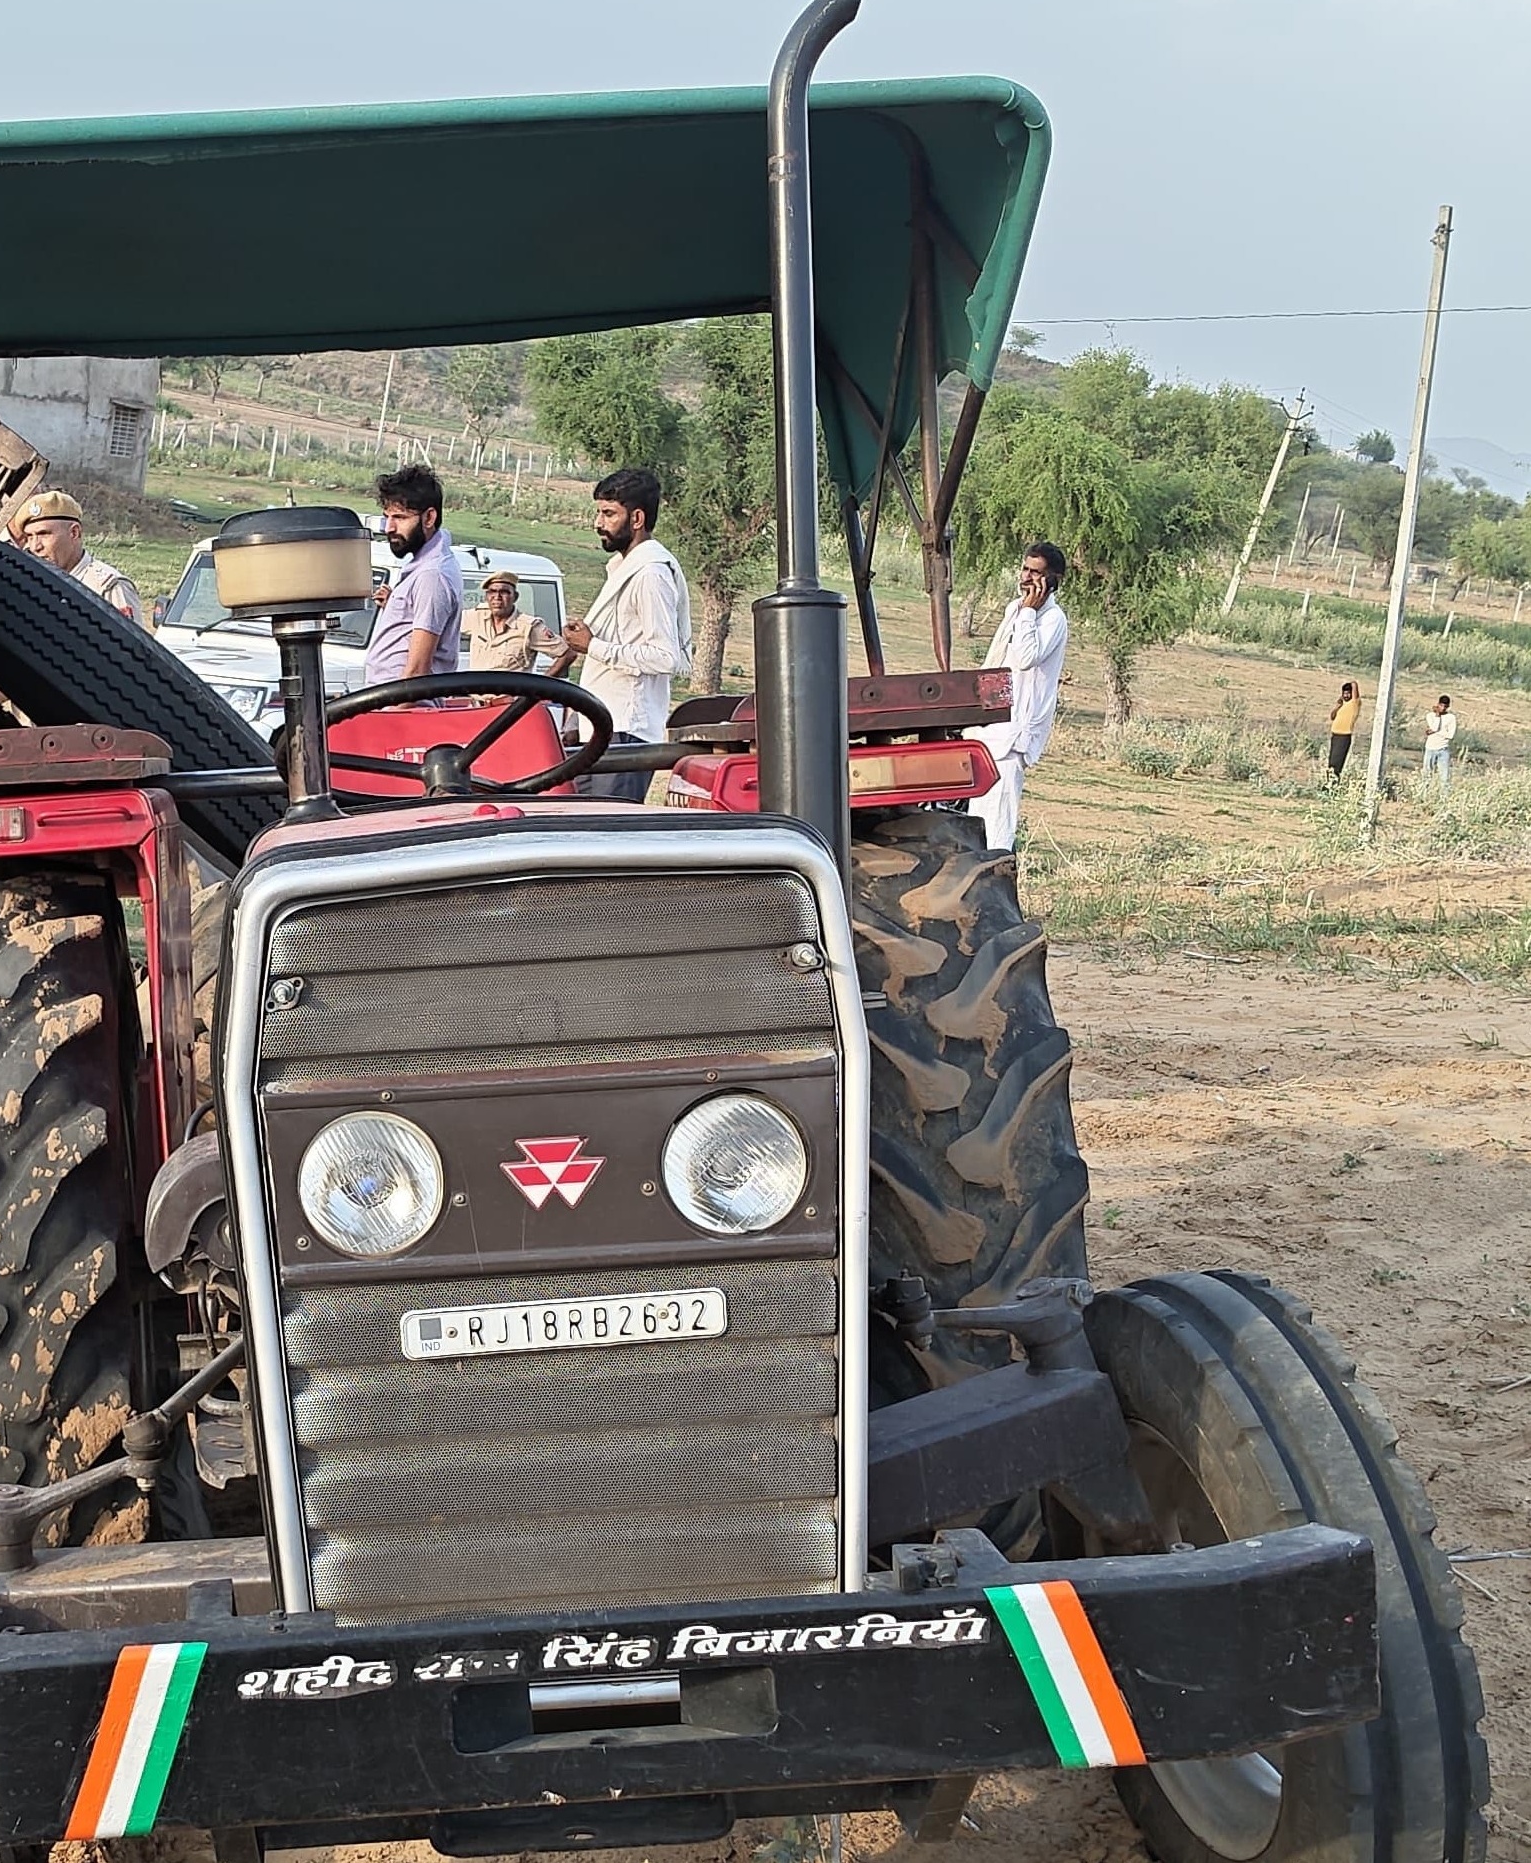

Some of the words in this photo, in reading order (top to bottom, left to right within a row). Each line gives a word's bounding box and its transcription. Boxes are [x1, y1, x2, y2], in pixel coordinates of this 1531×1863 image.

[420, 1340, 442, 1353] IND
[468, 1299, 708, 1347] RJ18RB2632
[237, 1655, 393, 1697] शहीद
[542, 1632, 652, 1669] सिंह
